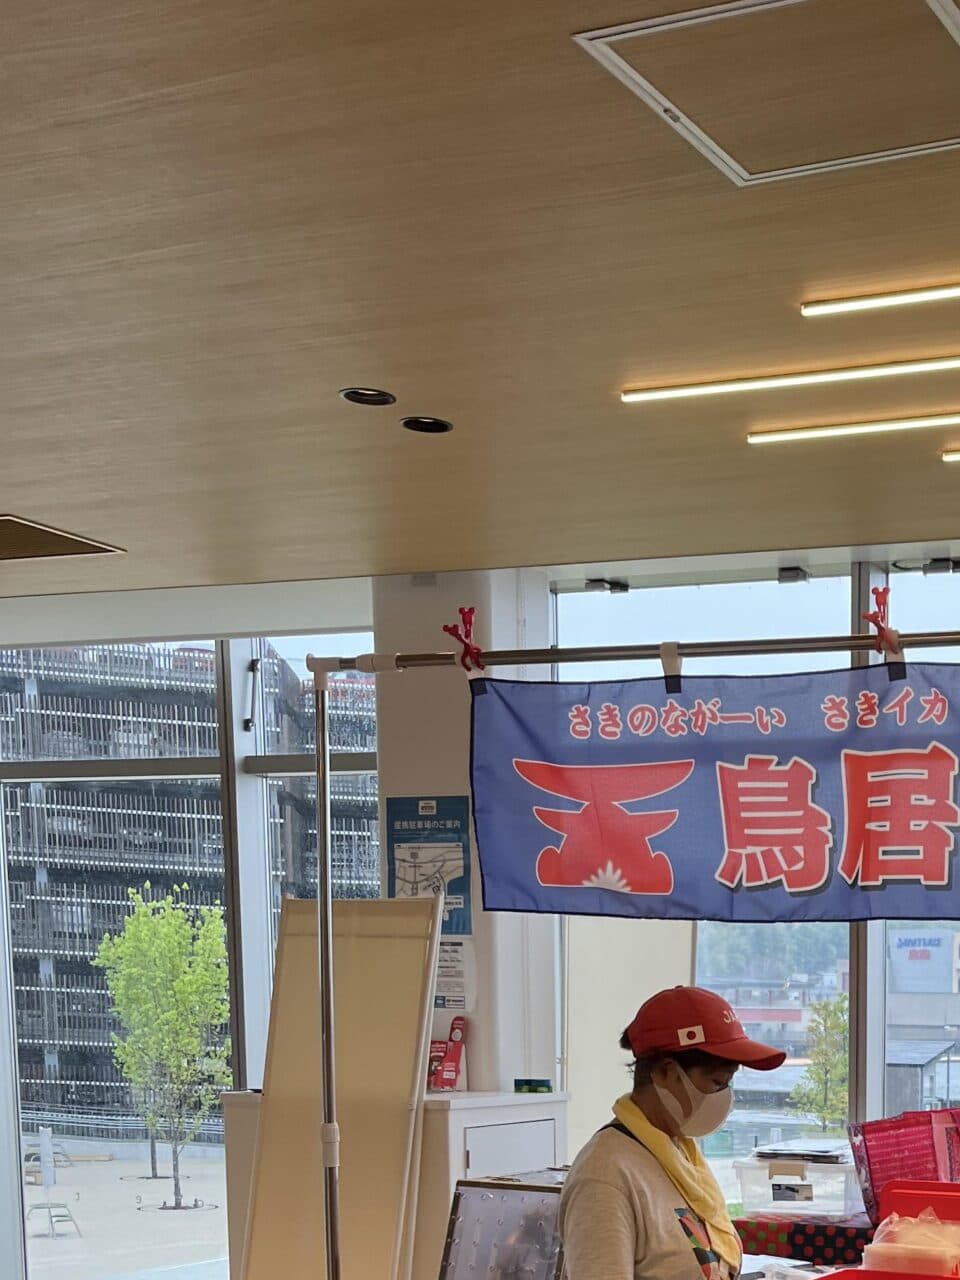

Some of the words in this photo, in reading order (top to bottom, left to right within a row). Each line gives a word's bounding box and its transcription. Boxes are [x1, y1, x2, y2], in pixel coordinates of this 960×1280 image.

[567, 698, 787, 740] さきのながーい
[821, 687, 950, 731] さきイカ
